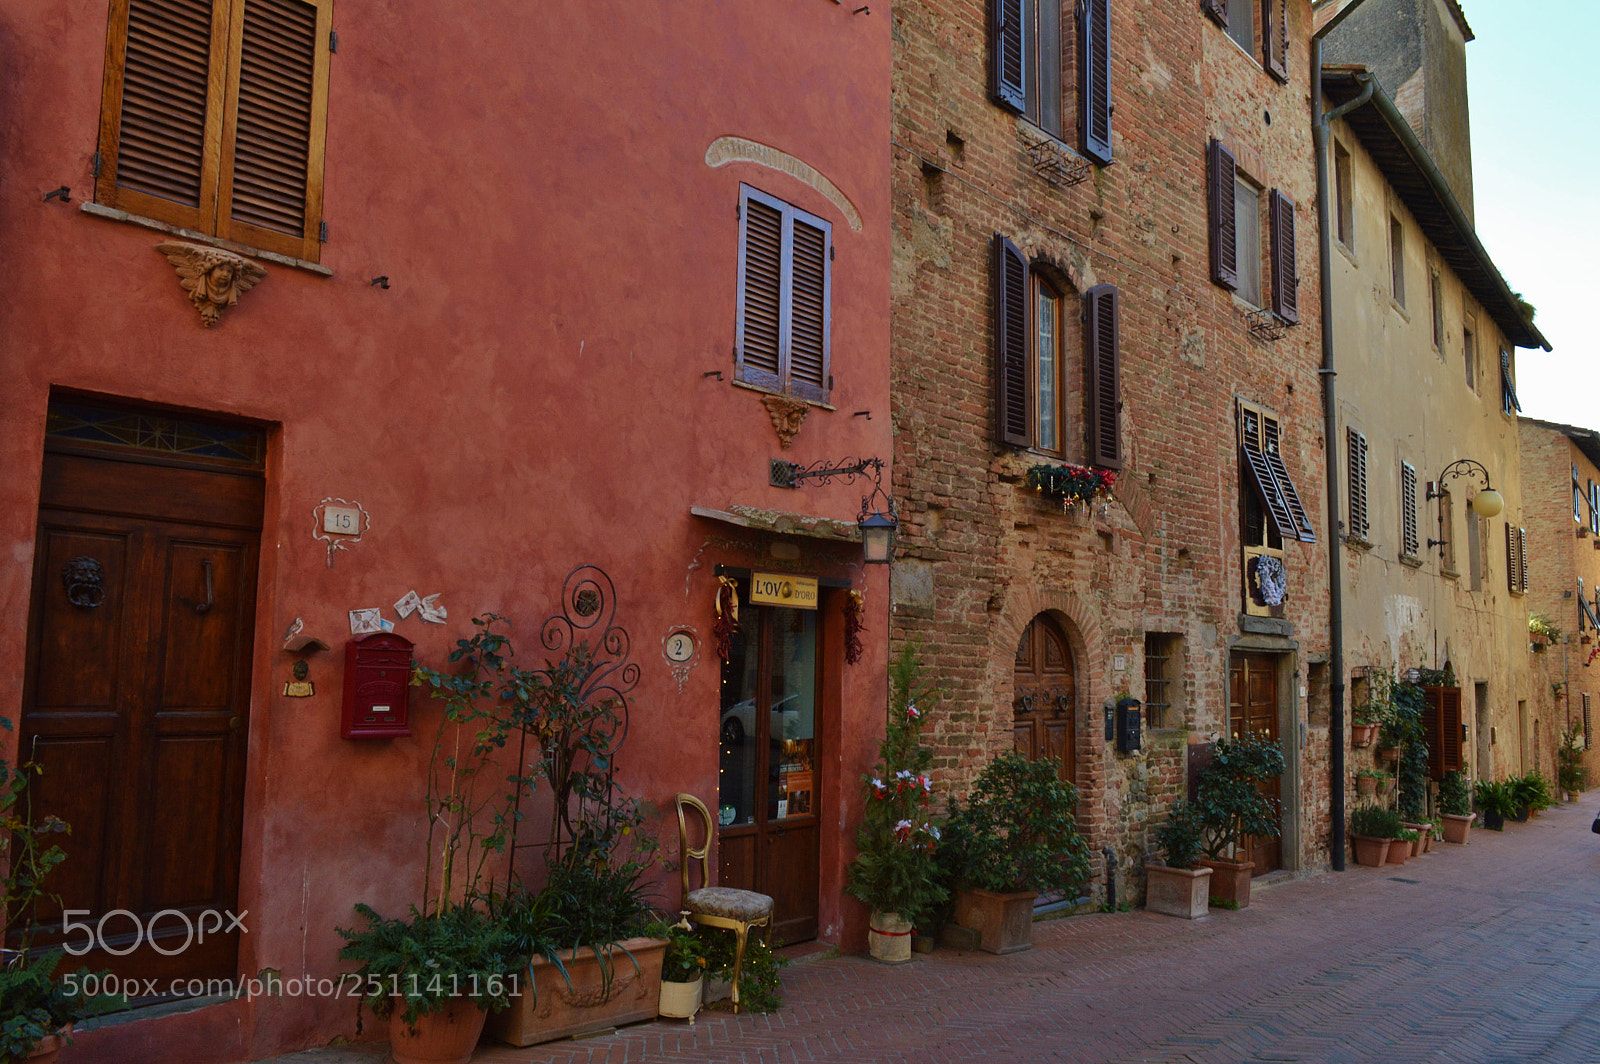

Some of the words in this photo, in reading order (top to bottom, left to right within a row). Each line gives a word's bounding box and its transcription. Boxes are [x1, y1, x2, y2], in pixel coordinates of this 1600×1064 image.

[336, 514, 351, 529] 15
[795, 589, 816, 601] D'ORO
[675, 639, 683, 655] 2
